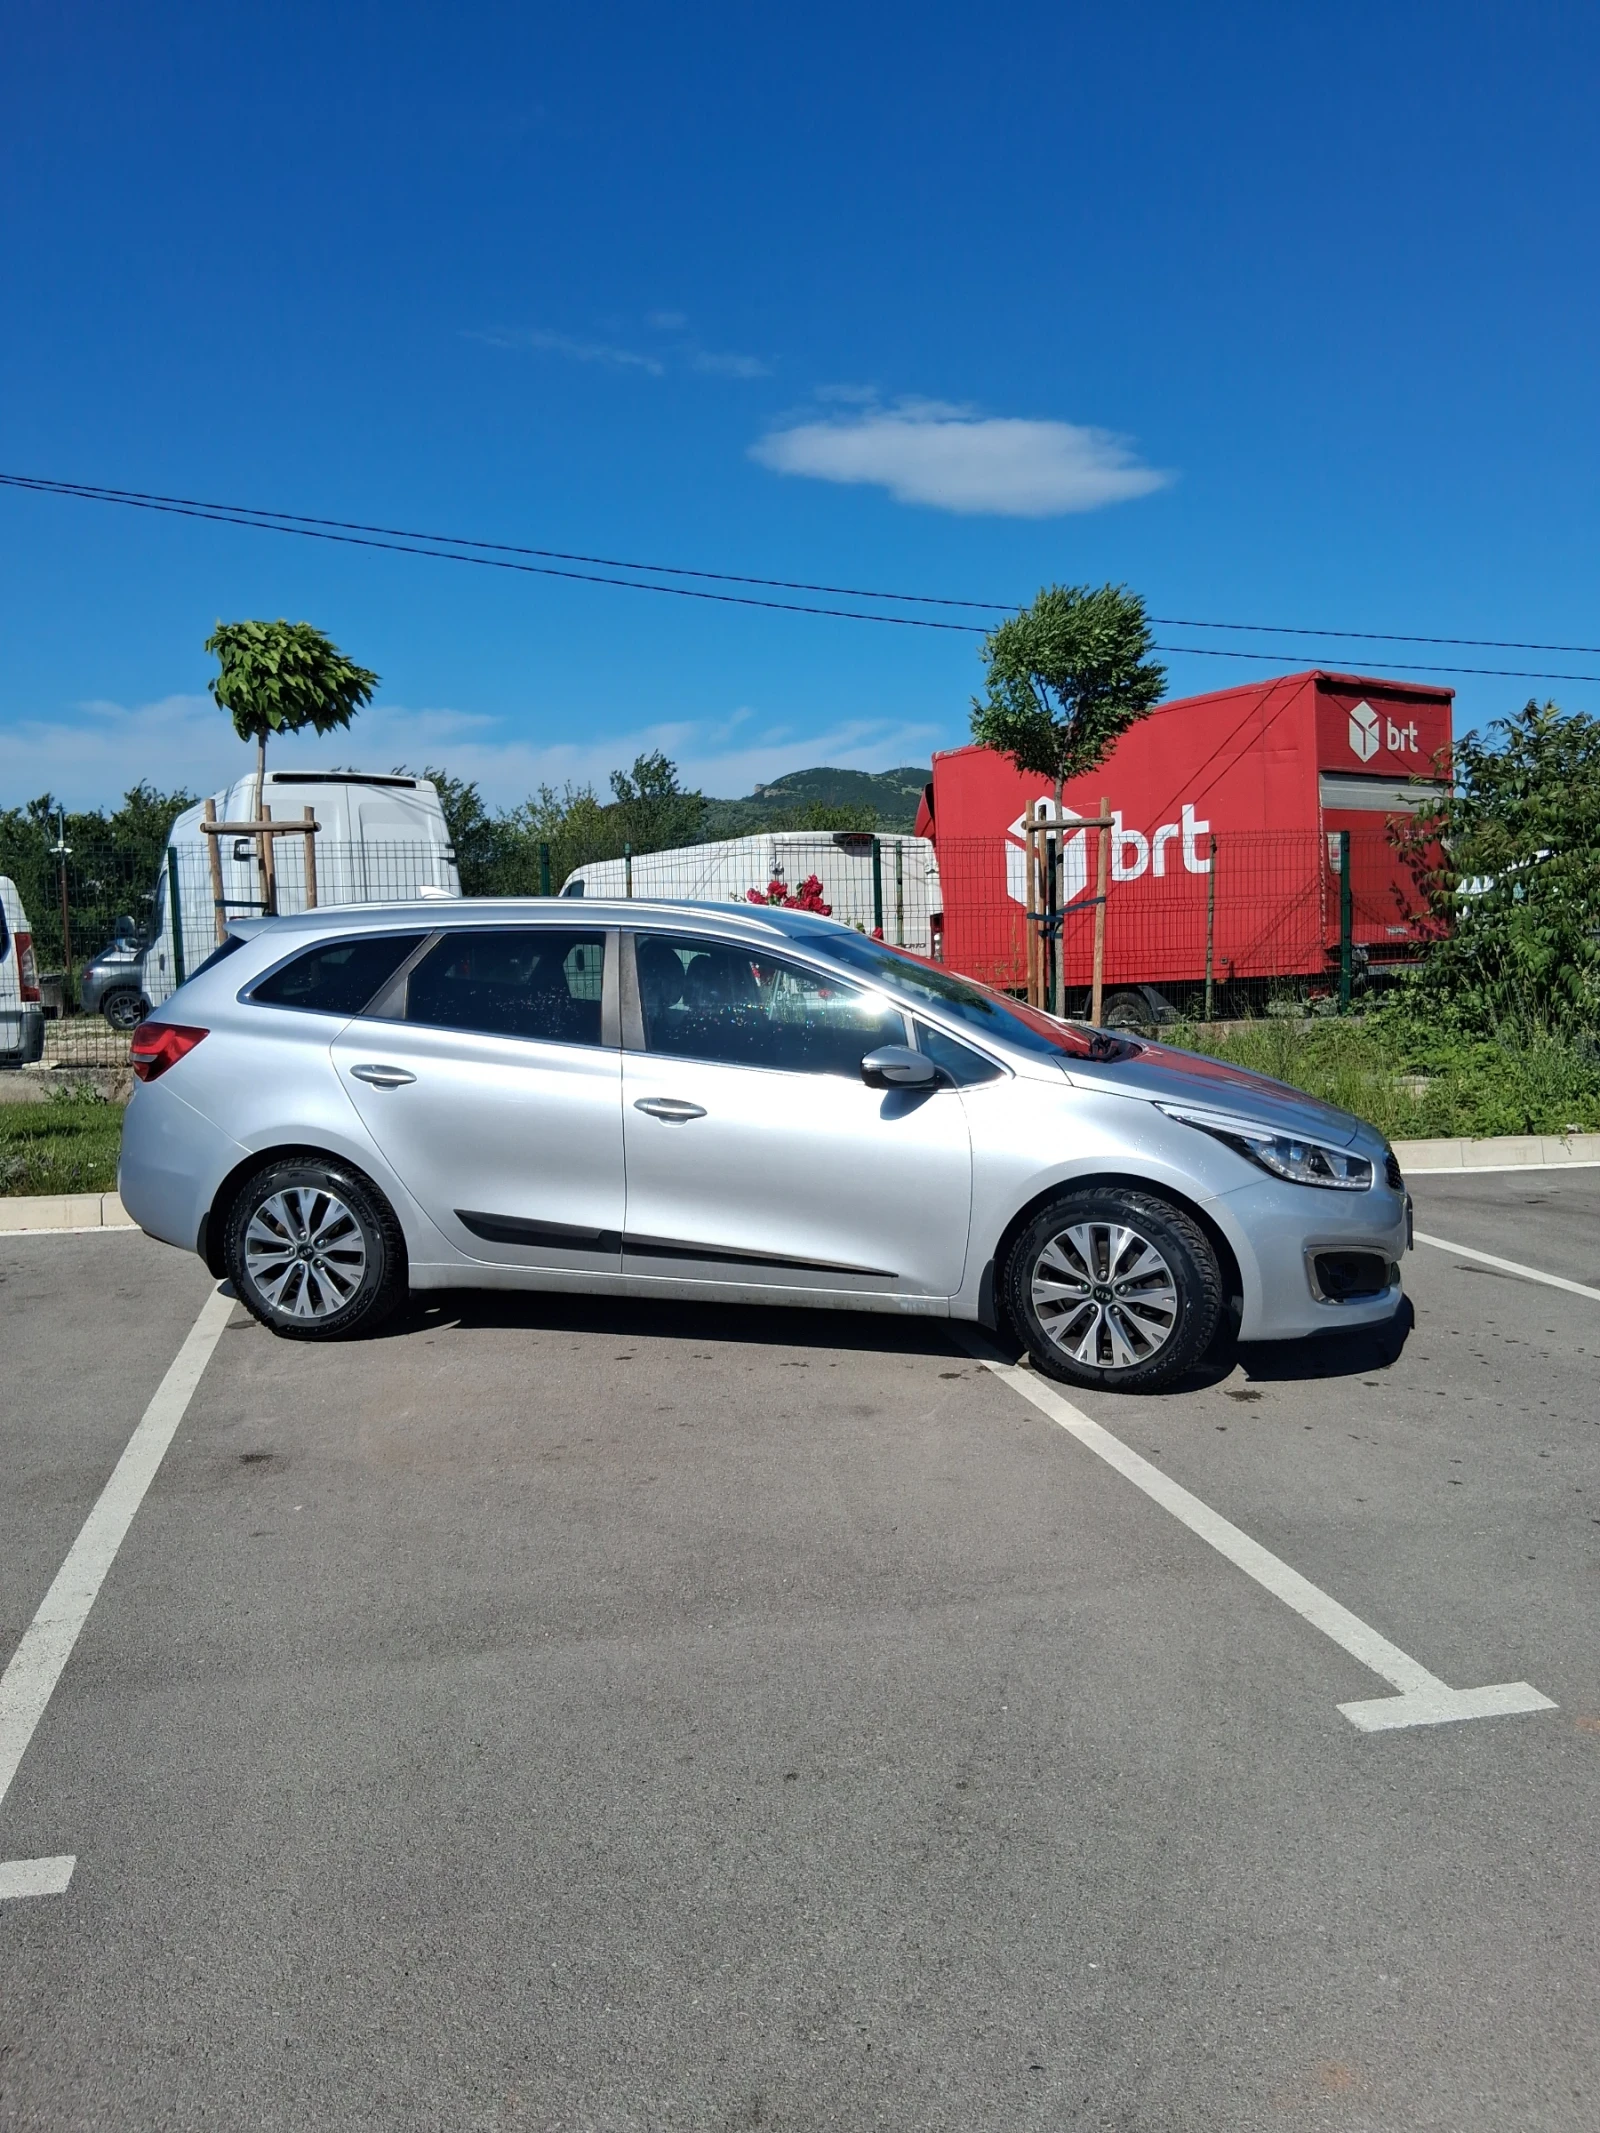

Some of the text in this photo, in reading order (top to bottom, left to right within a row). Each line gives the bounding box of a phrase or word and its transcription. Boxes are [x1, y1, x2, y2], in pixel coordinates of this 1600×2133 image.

[1387, 716, 1419, 753] brt
[1111, 803, 1211, 881] brt
[299, 1247, 313, 1258] KIA
[1095, 1289, 1111, 1300] KIA
